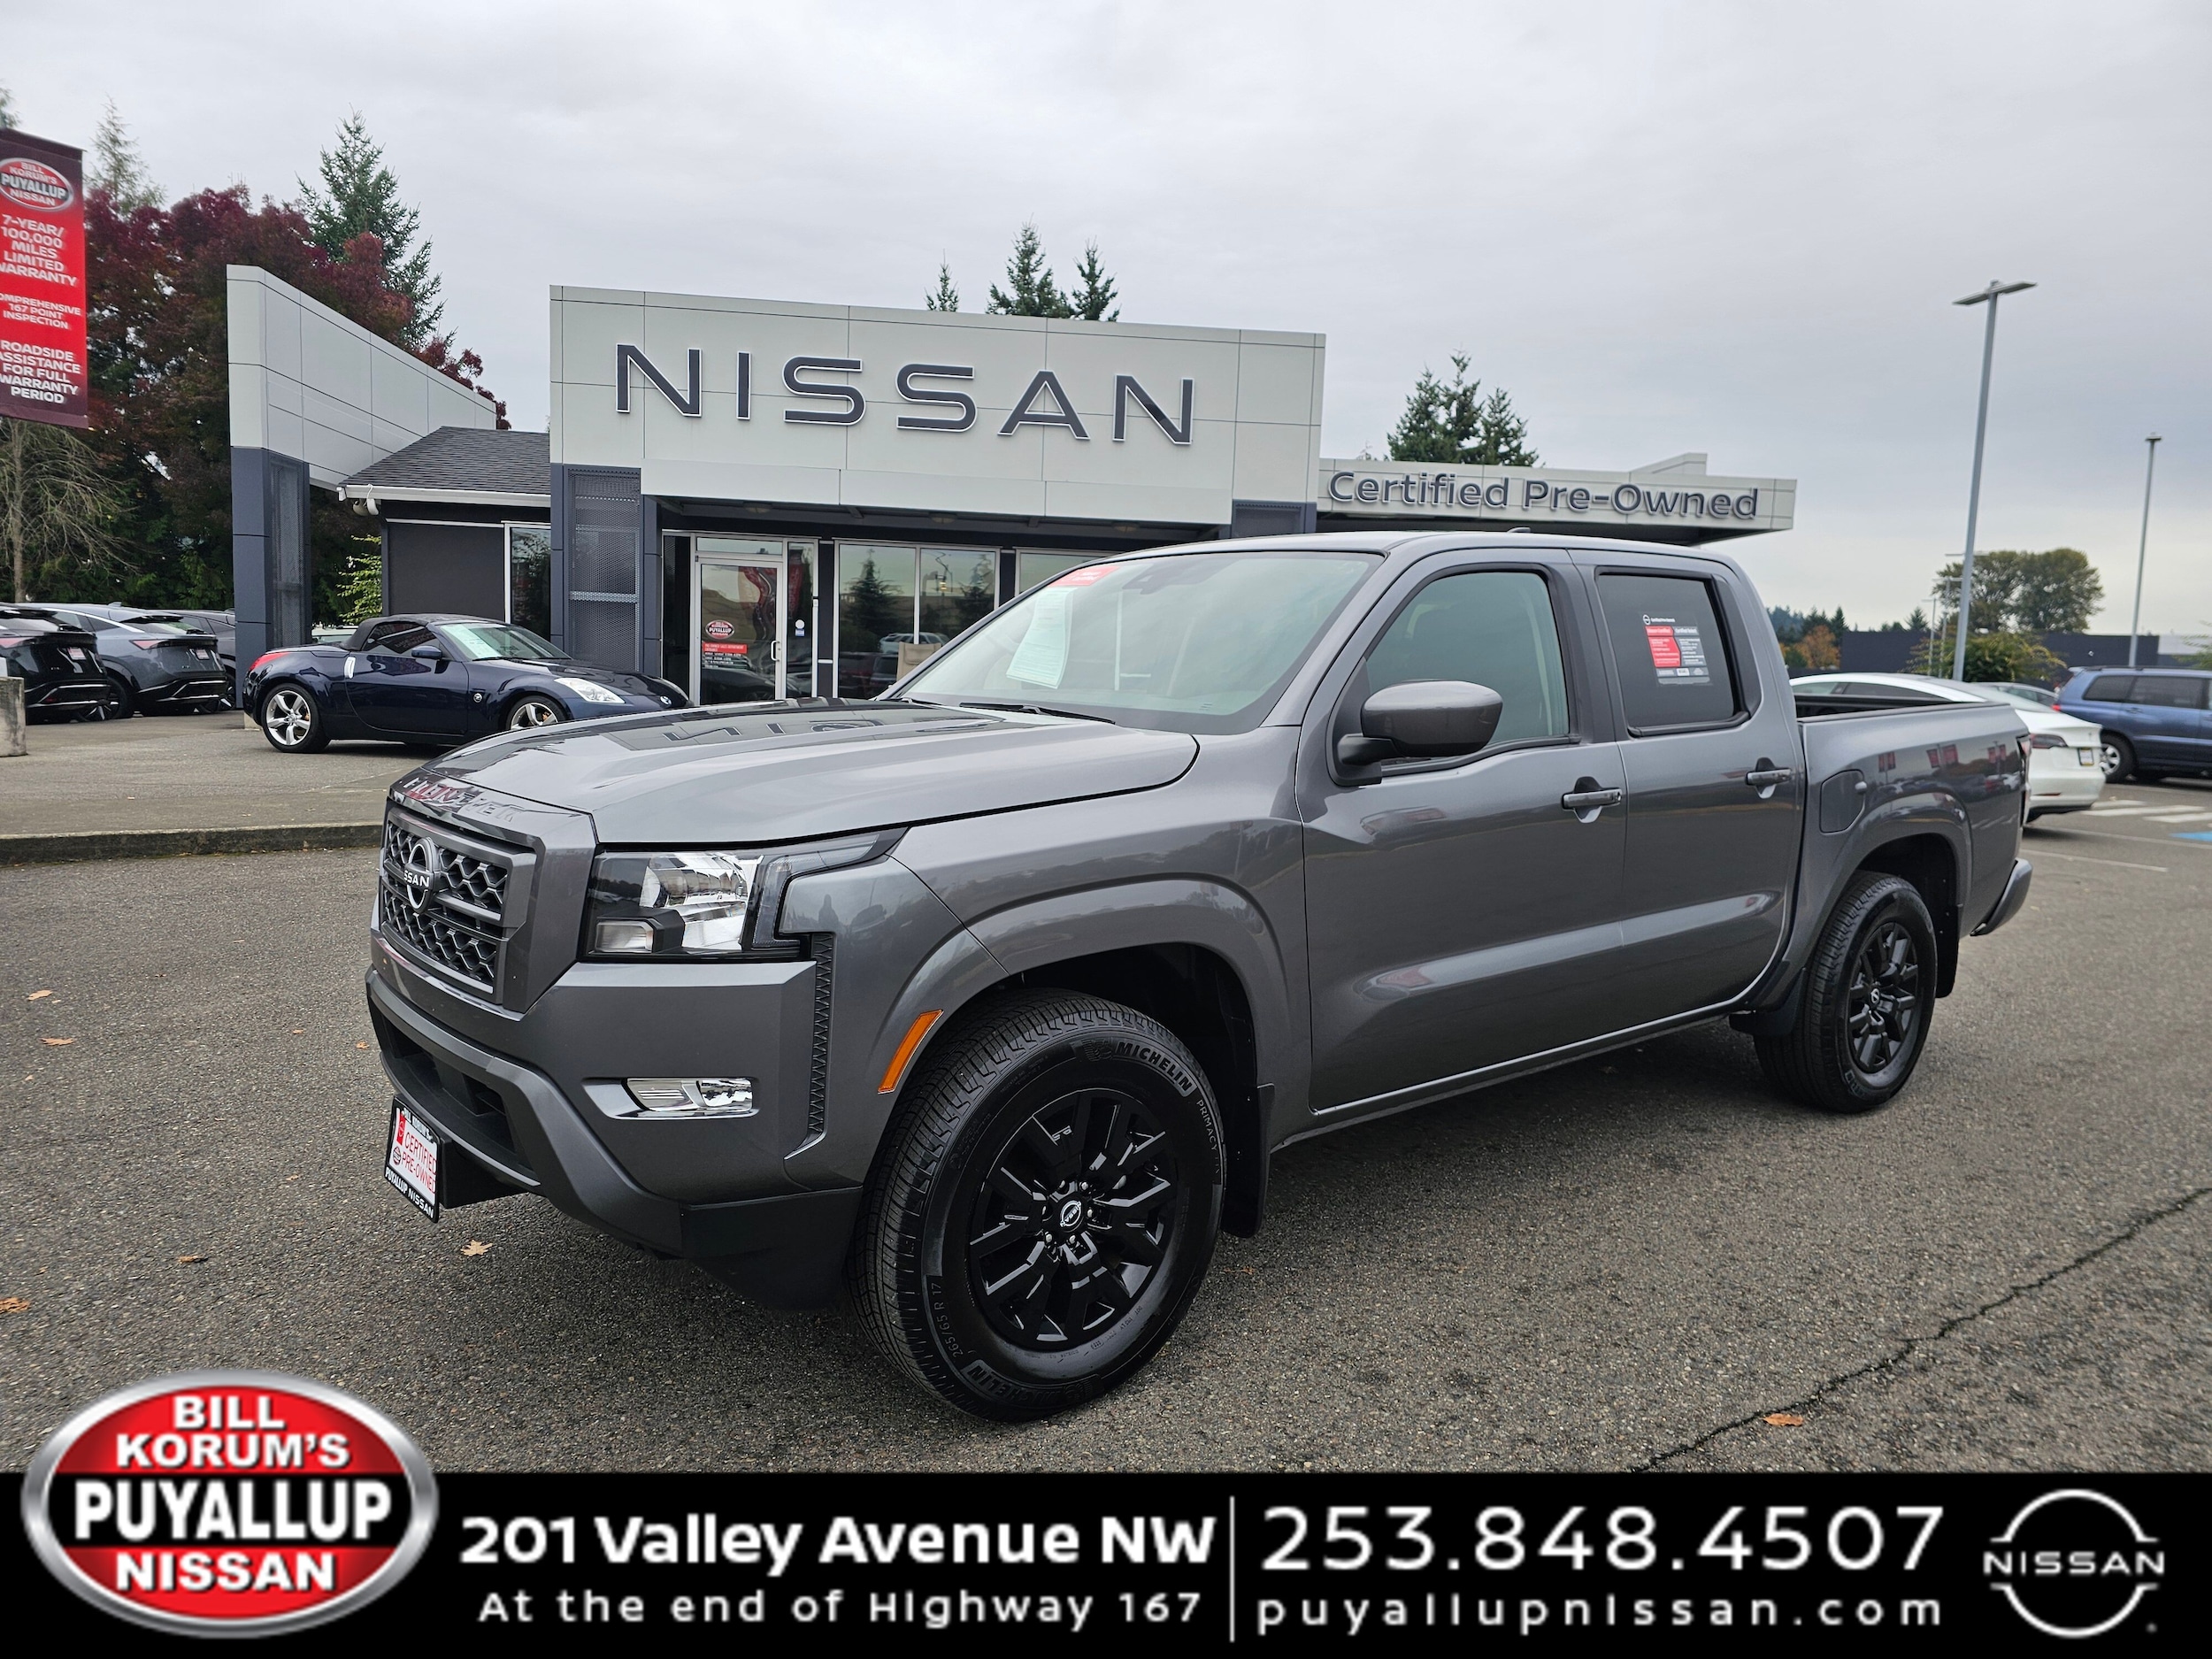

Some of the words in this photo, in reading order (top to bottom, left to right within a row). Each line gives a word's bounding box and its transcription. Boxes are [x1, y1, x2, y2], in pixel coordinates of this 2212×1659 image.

[21, 162, 44, 174] BILL
[1, 173, 66, 199] PUYALLUP
[10, 188, 56, 206] NISSAN
[2, 213, 65, 237] 7-YEAR/
[12, 240, 58, 259] MILES
[4, 250, 65, 272] LIMITED
[0, 293, 81, 316] OMPREHENSIVE
[9, 303, 28, 312] 167
[30, 307, 63, 319] POINT
[4, 311, 69, 329] INSPECTION
[0, 340, 74, 362] ROADSIDE
[3, 363, 34, 377] FOR
[36, 368, 71, 383] FULL
[0, 374, 79, 395] WARRANTY
[11, 387, 65, 404] PERIOD
[615, 342, 1194, 445] NISSAN
[1328, 469, 1509, 508] Certified
[1523, 479, 1759, 520] Pre-Owned
[403, 870, 430, 887] SSAN
[1116, 1041, 1193, 1092] MICHELIN
[1196, 1099, 1218, 1151] PRIMACY
[405, 1132, 437, 1175] CERTIFIED
[401, 1152, 436, 1194] PRE-OWNED
[385, 1167, 408, 1194] PUYALLUP
[408, 1188, 434, 1218] NISSAN
[932, 1283, 942, 1296] 17
[934, 1302, 945, 1310] R
[936, 1315, 964, 1358] 265/65
